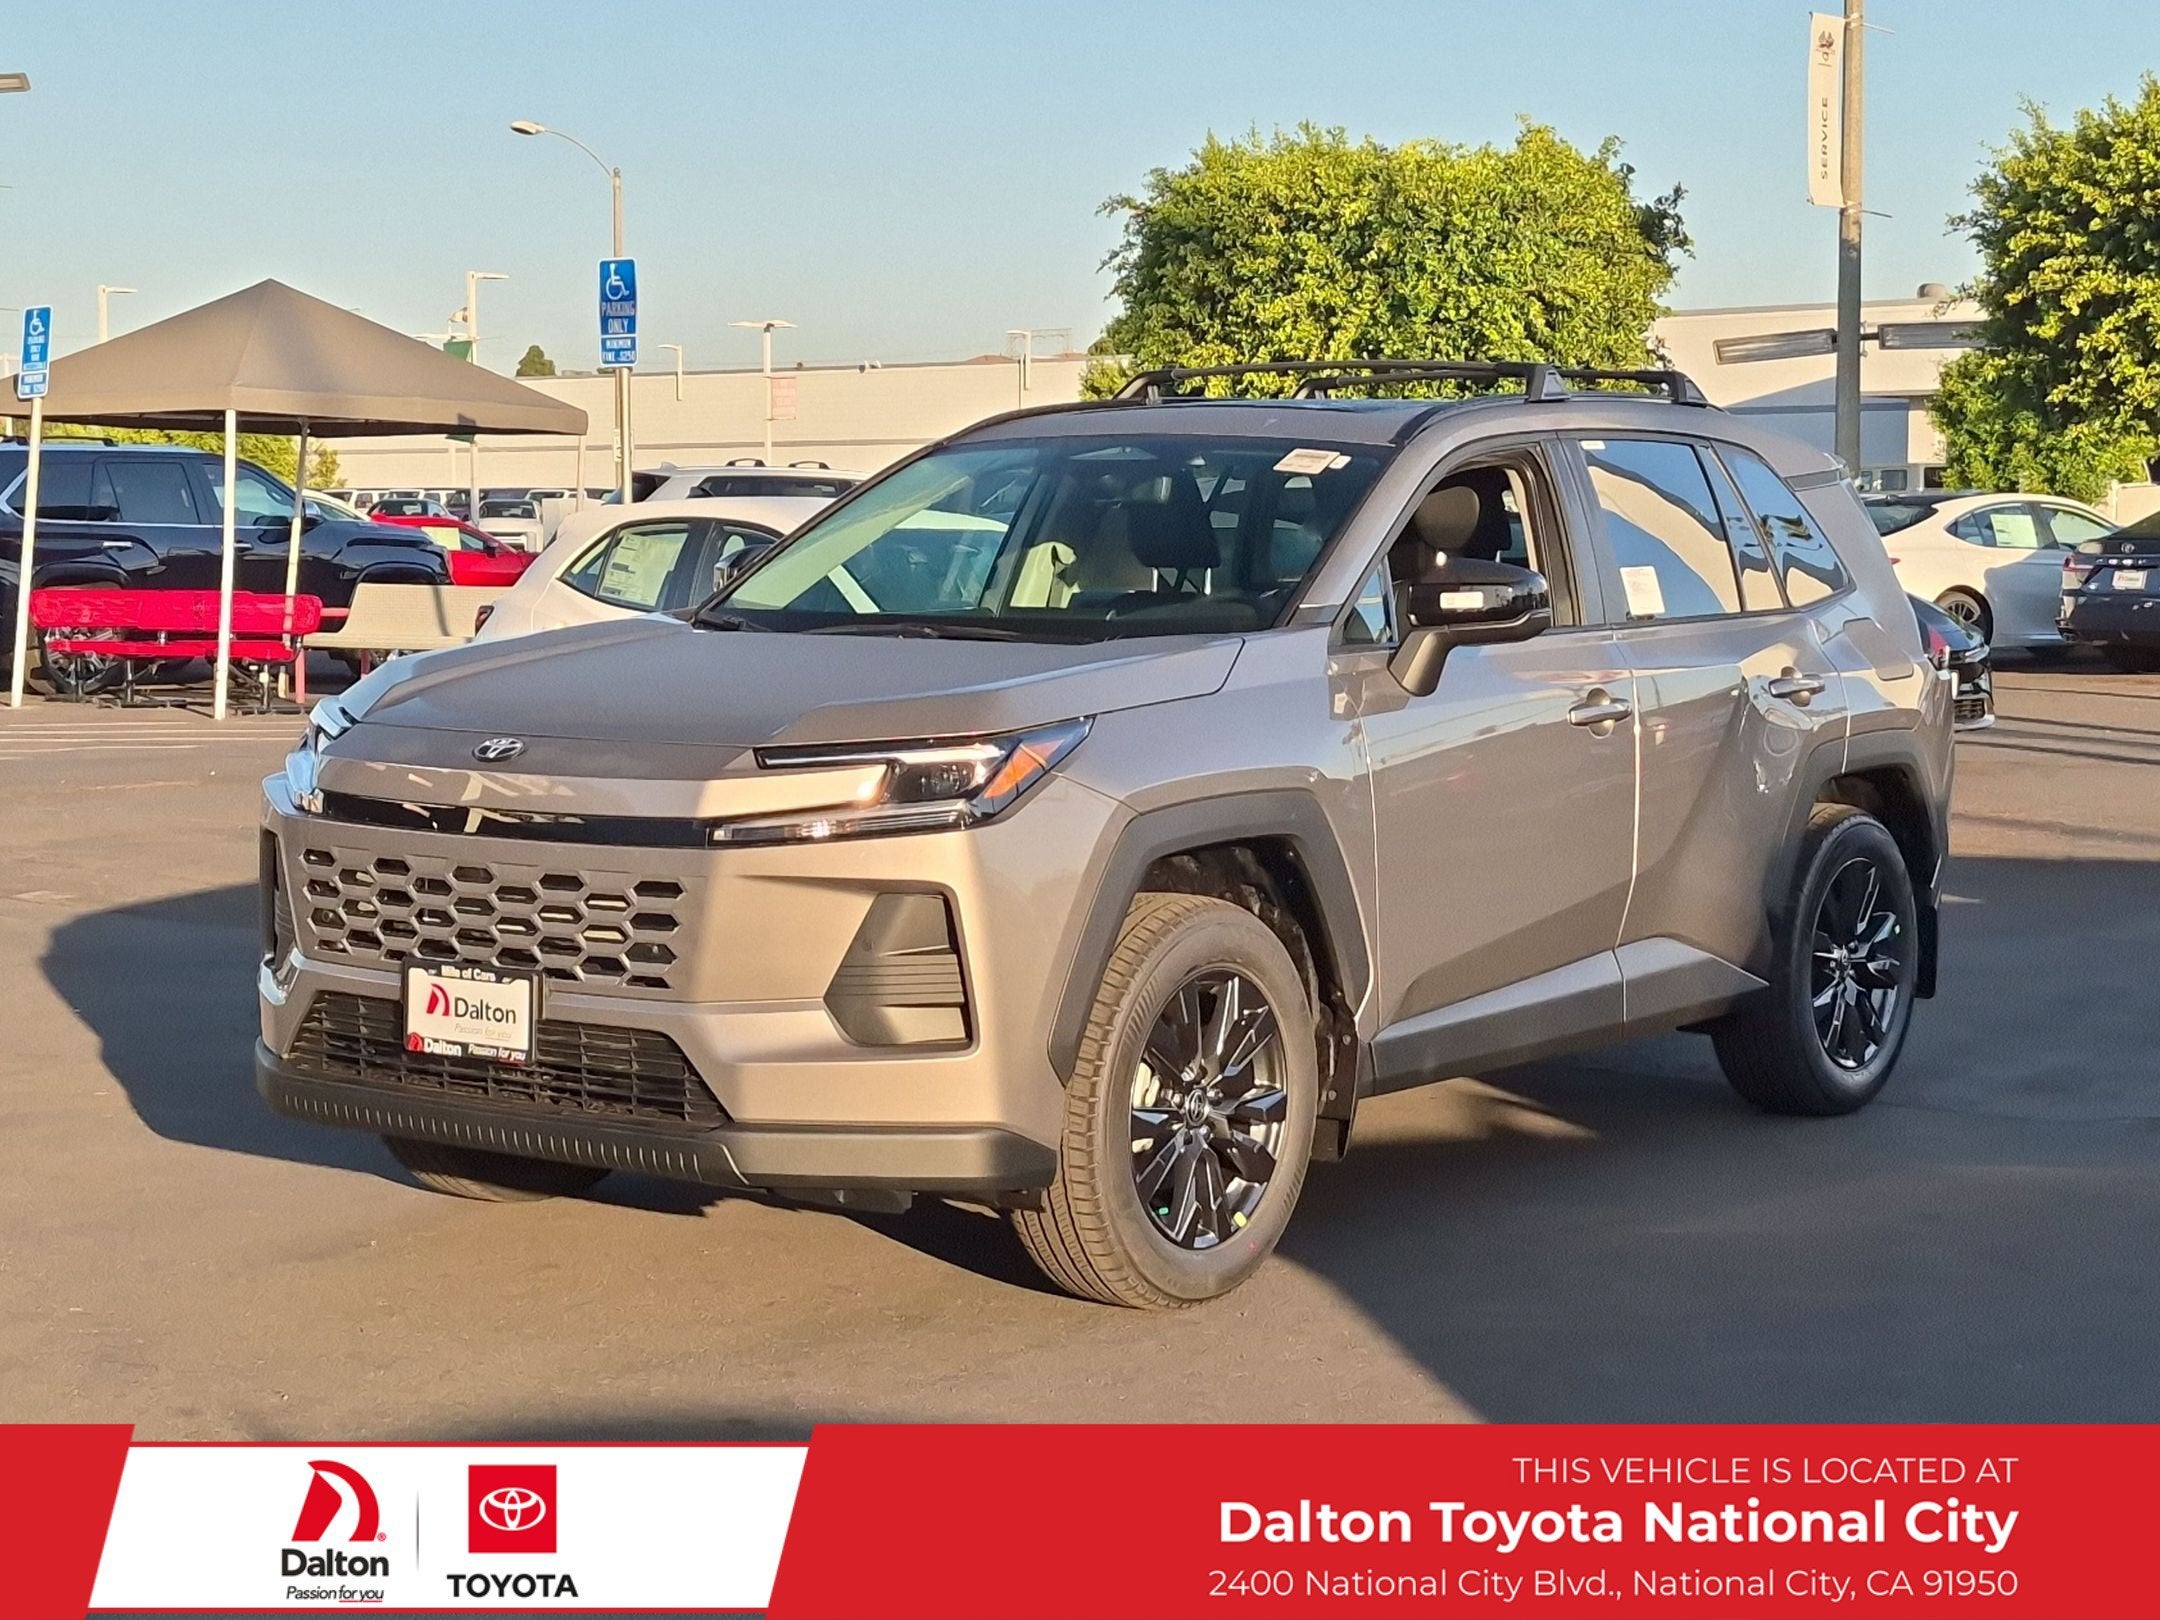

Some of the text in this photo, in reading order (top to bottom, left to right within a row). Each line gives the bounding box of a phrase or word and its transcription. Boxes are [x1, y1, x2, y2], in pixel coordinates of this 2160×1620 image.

[601, 301, 635, 316] PARKING
[608, 318, 629, 333] ONLY
[462, 967, 472, 979] of
[473, 968, 496, 982] Cars
[454, 997, 516, 1024] Dalton
[424, 1038, 462, 1057] Dalton
[498, 1047, 510, 1059] for
[510, 1050, 526, 1062] you
